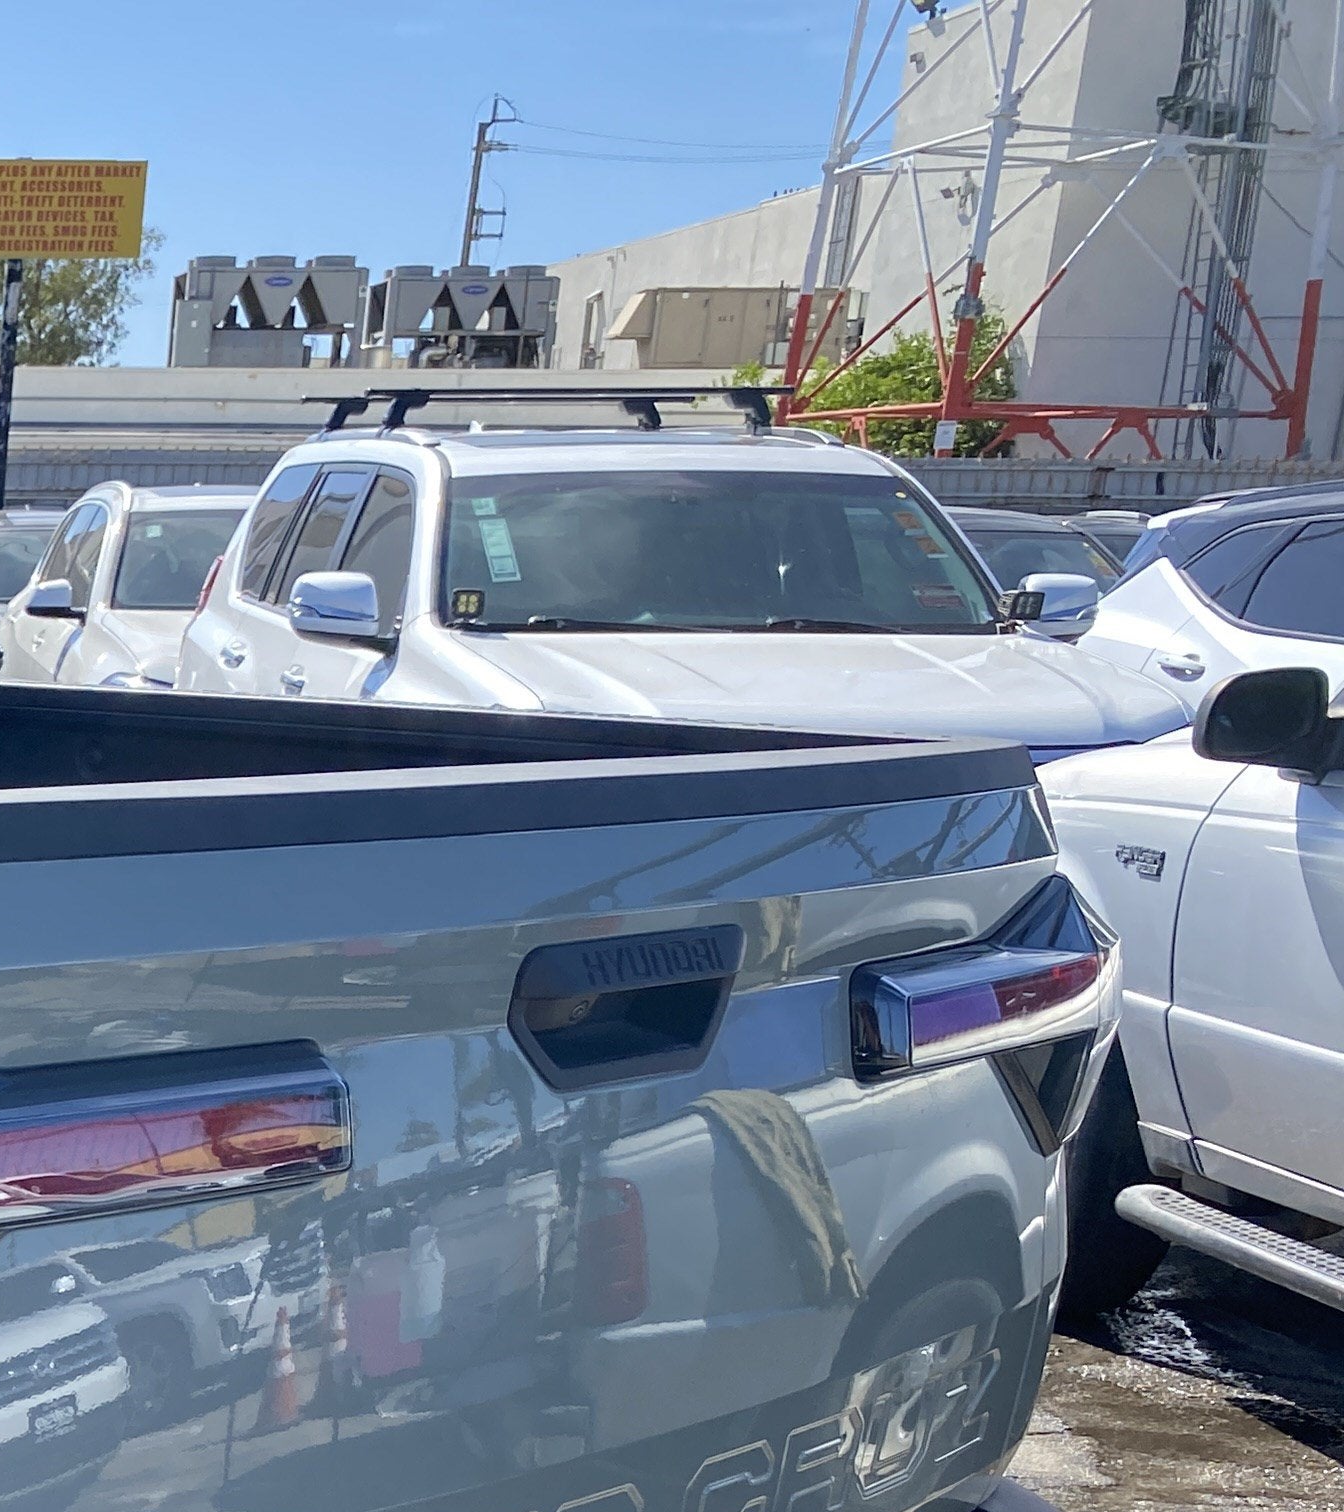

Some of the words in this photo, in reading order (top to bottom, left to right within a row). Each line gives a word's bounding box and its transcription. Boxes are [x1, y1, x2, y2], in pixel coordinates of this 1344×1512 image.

[30, 165, 53, 177] ANY
[55, 165, 90, 177] AFTER
[94, 165, 141, 177] MARKET
[53, 225, 87, 237] SMOG
[581, 936, 724, 986] HYUNDAI
